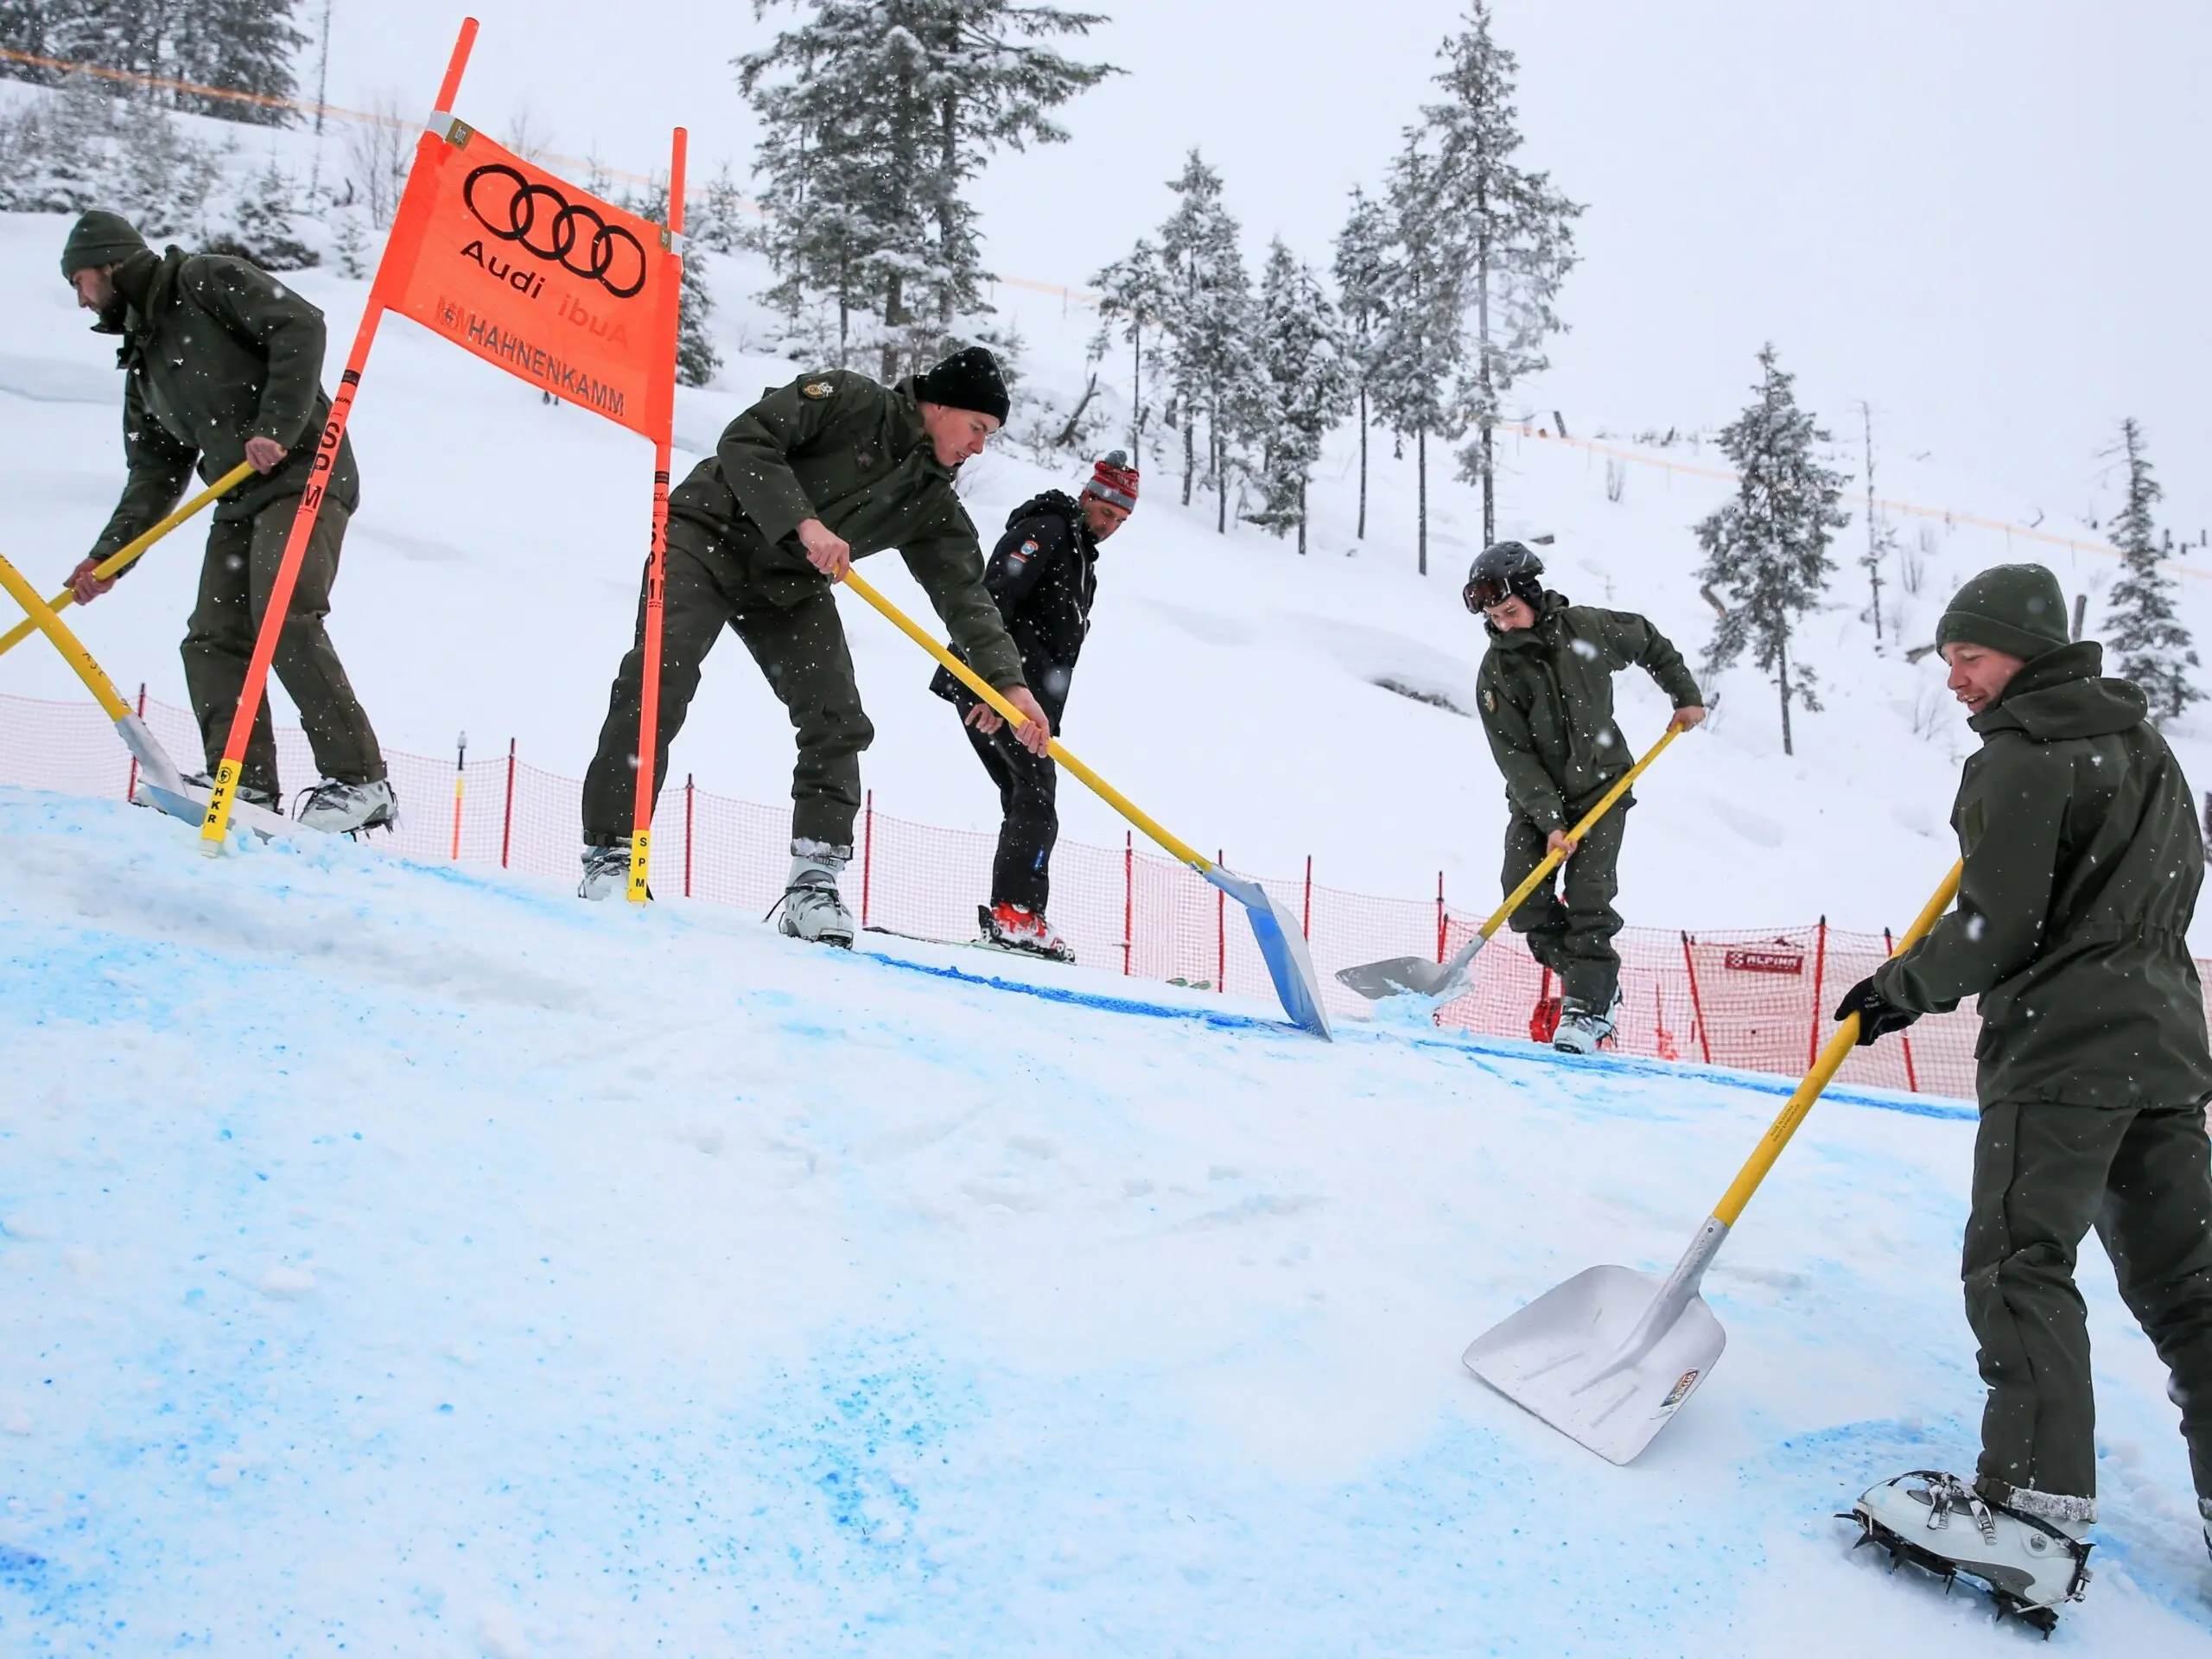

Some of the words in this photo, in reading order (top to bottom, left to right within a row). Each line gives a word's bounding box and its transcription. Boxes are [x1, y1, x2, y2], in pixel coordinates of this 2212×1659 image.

[460, 240, 545, 299] Audi
[467, 314, 625, 416] HAHNENKAMM
[207, 787, 224, 823] HKR
[635, 837, 647, 888] SPM
